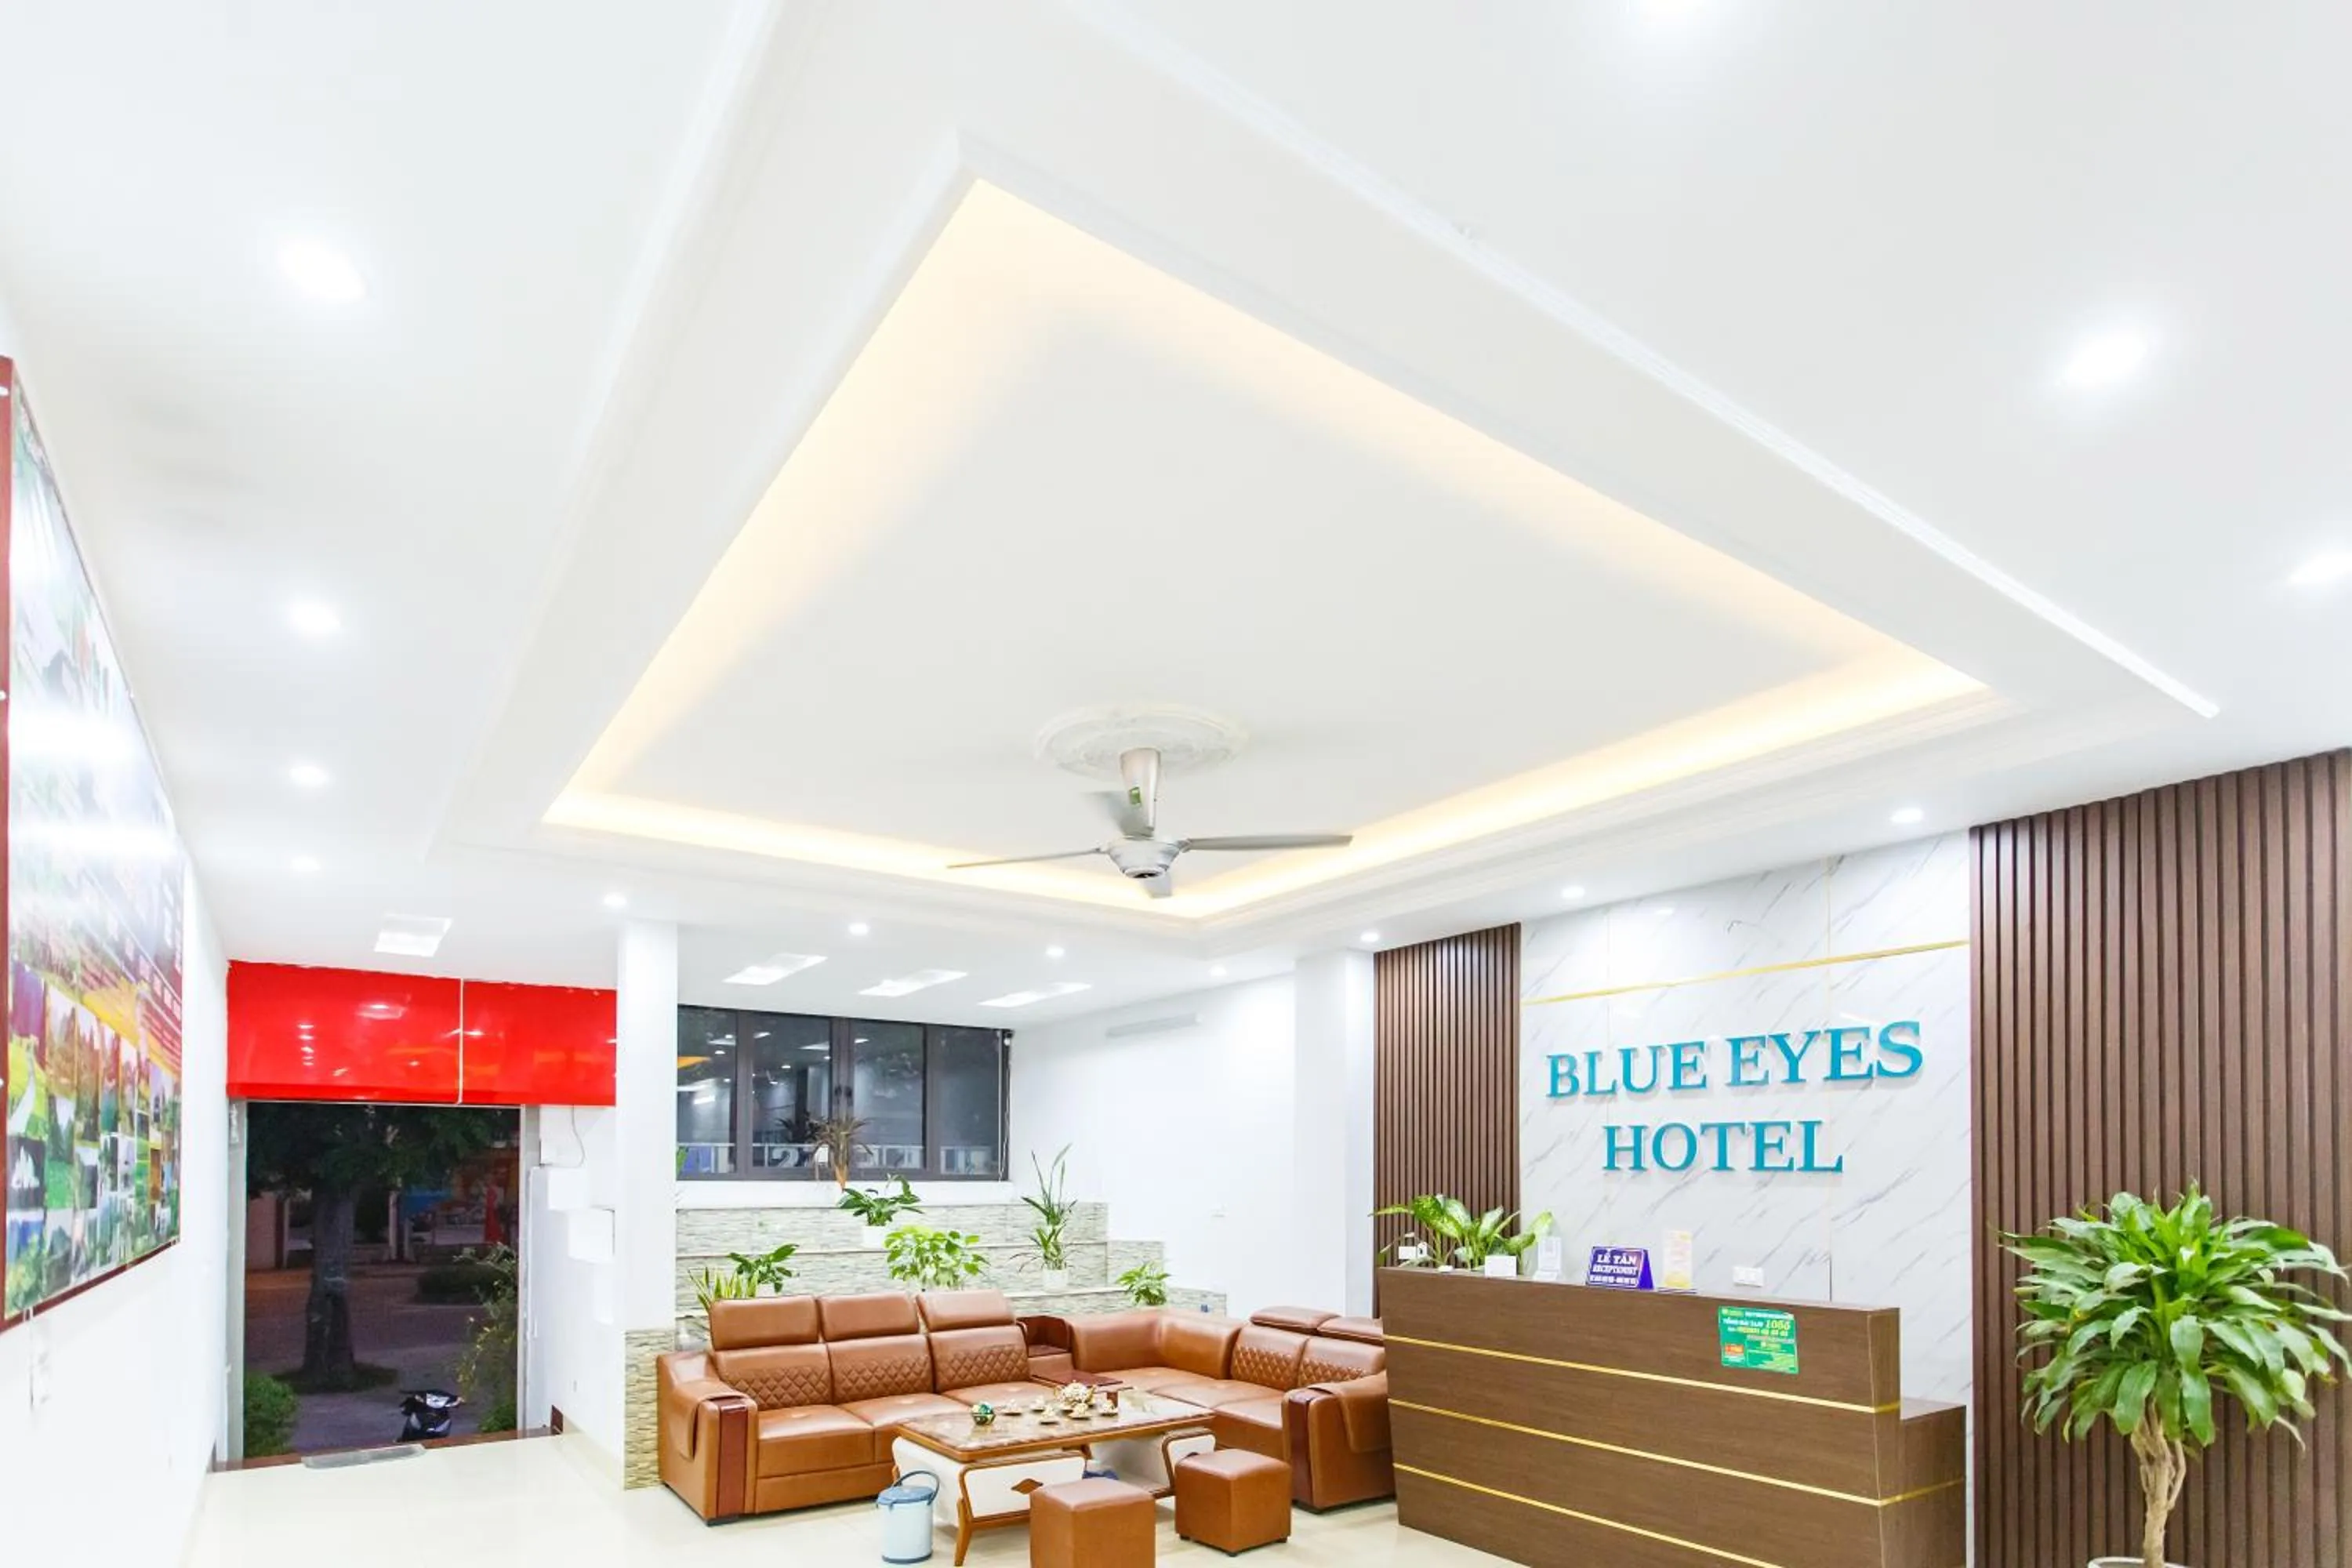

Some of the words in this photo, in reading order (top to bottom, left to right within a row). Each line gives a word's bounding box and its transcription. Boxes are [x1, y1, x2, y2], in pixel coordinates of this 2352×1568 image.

[1546, 1041, 1708, 1098] BLUE
[1726, 1022, 1923, 1087] EYES
[1602, 1120, 1843, 1173] HOTEL
